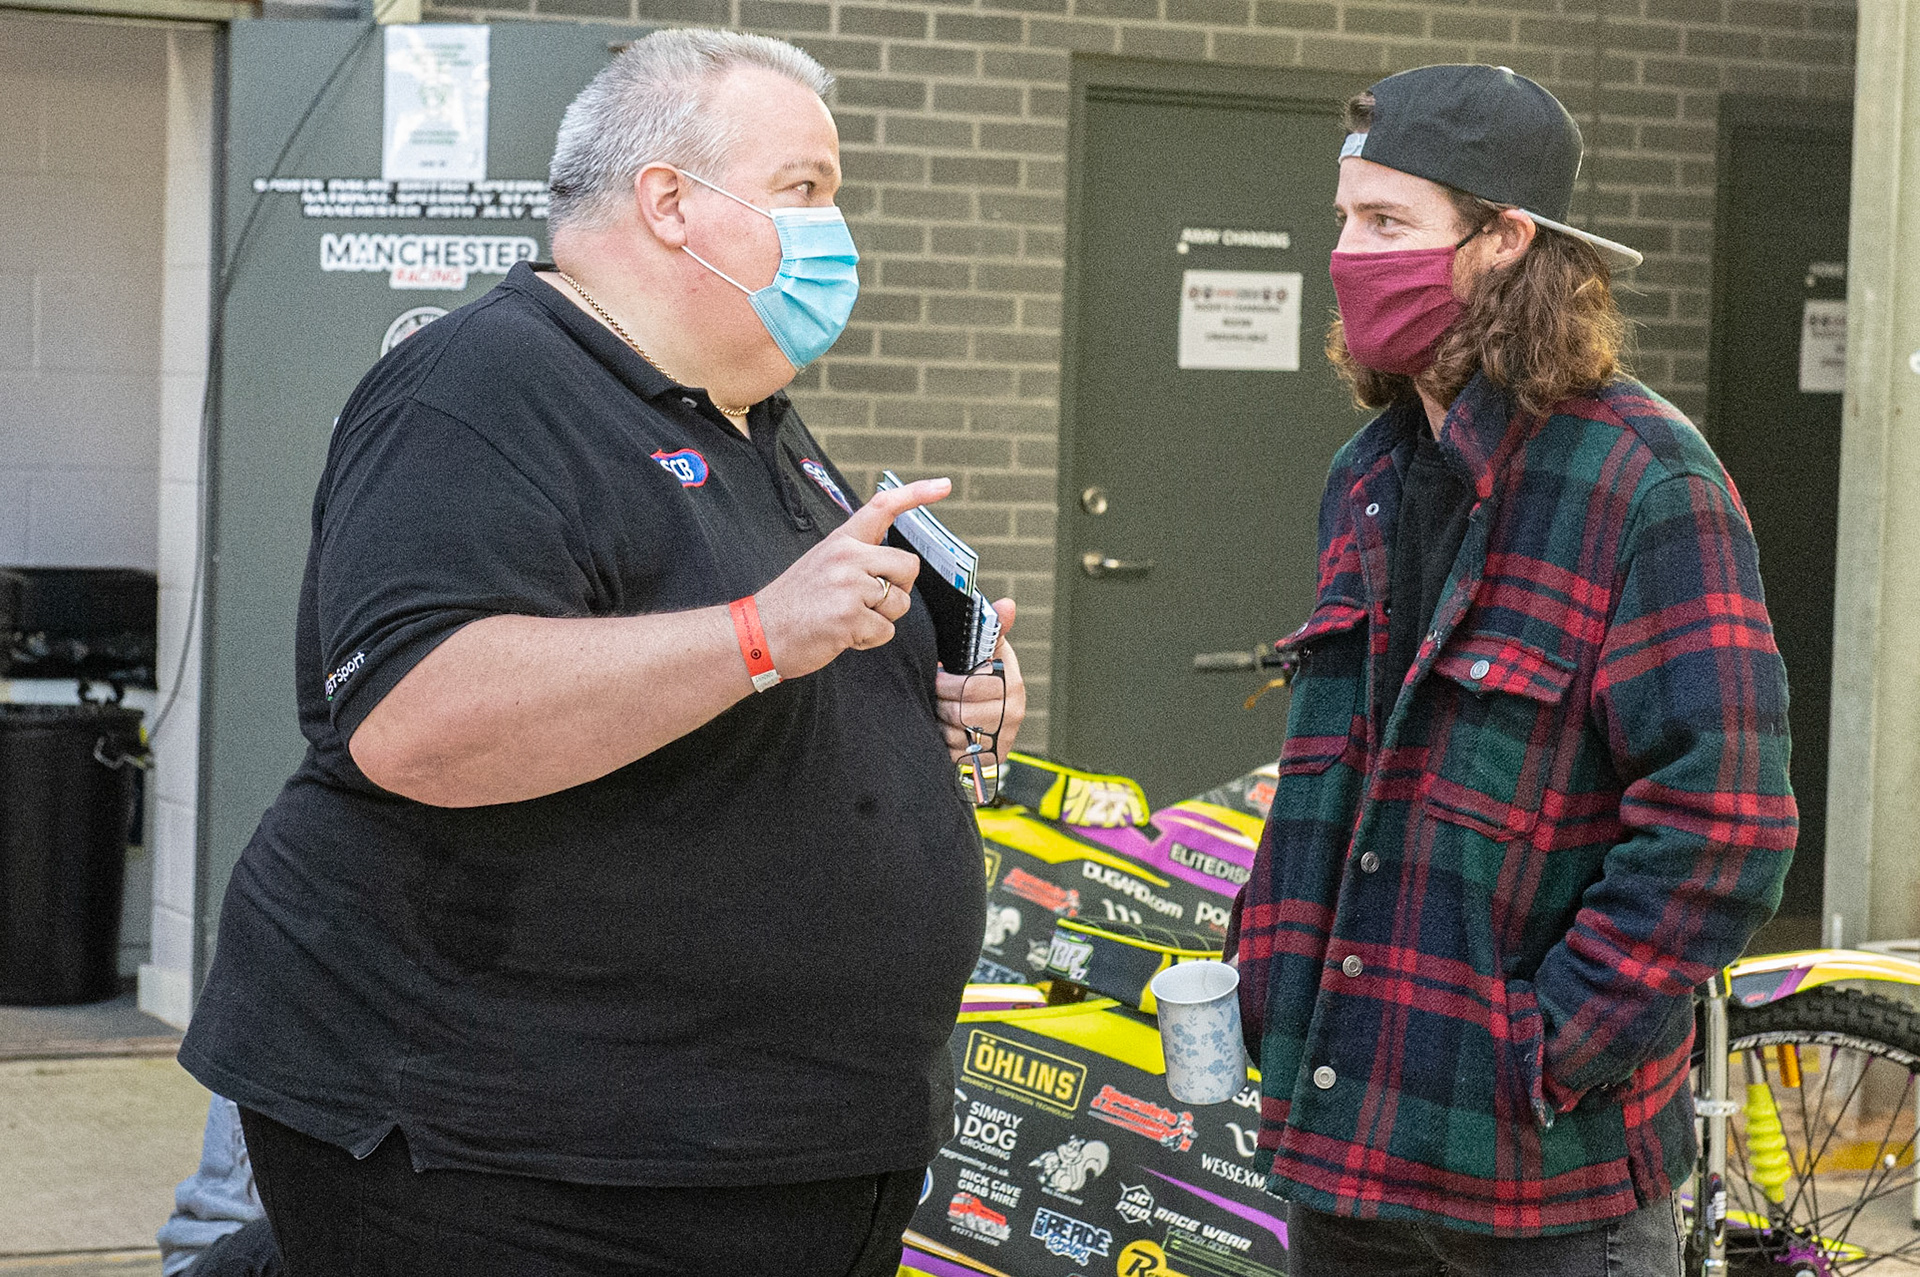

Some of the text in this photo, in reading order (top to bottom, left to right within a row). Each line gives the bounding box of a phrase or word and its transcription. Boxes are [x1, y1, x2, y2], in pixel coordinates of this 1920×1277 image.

[325, 239, 532, 268] MANCHESTER
[974, 1036, 1076, 1100] ÖHLINS
[969, 1101, 1023, 1130] SIMPLY
[962, 1115, 1018, 1150] DOG
[959, 1136, 1012, 1161] GROOMING
[957, 1178, 989, 1198] GRAB
[989, 1190, 1019, 1208] HIRE
[960, 1168, 990, 1187] MICK
[990, 1180, 1022, 1198] CAVE
[1115, 1200, 1151, 1220] PRO
[1126, 1191, 1150, 1206] JC
[1153, 1207, 1201, 1232] RACE
[1202, 1224, 1253, 1251] WEAR
